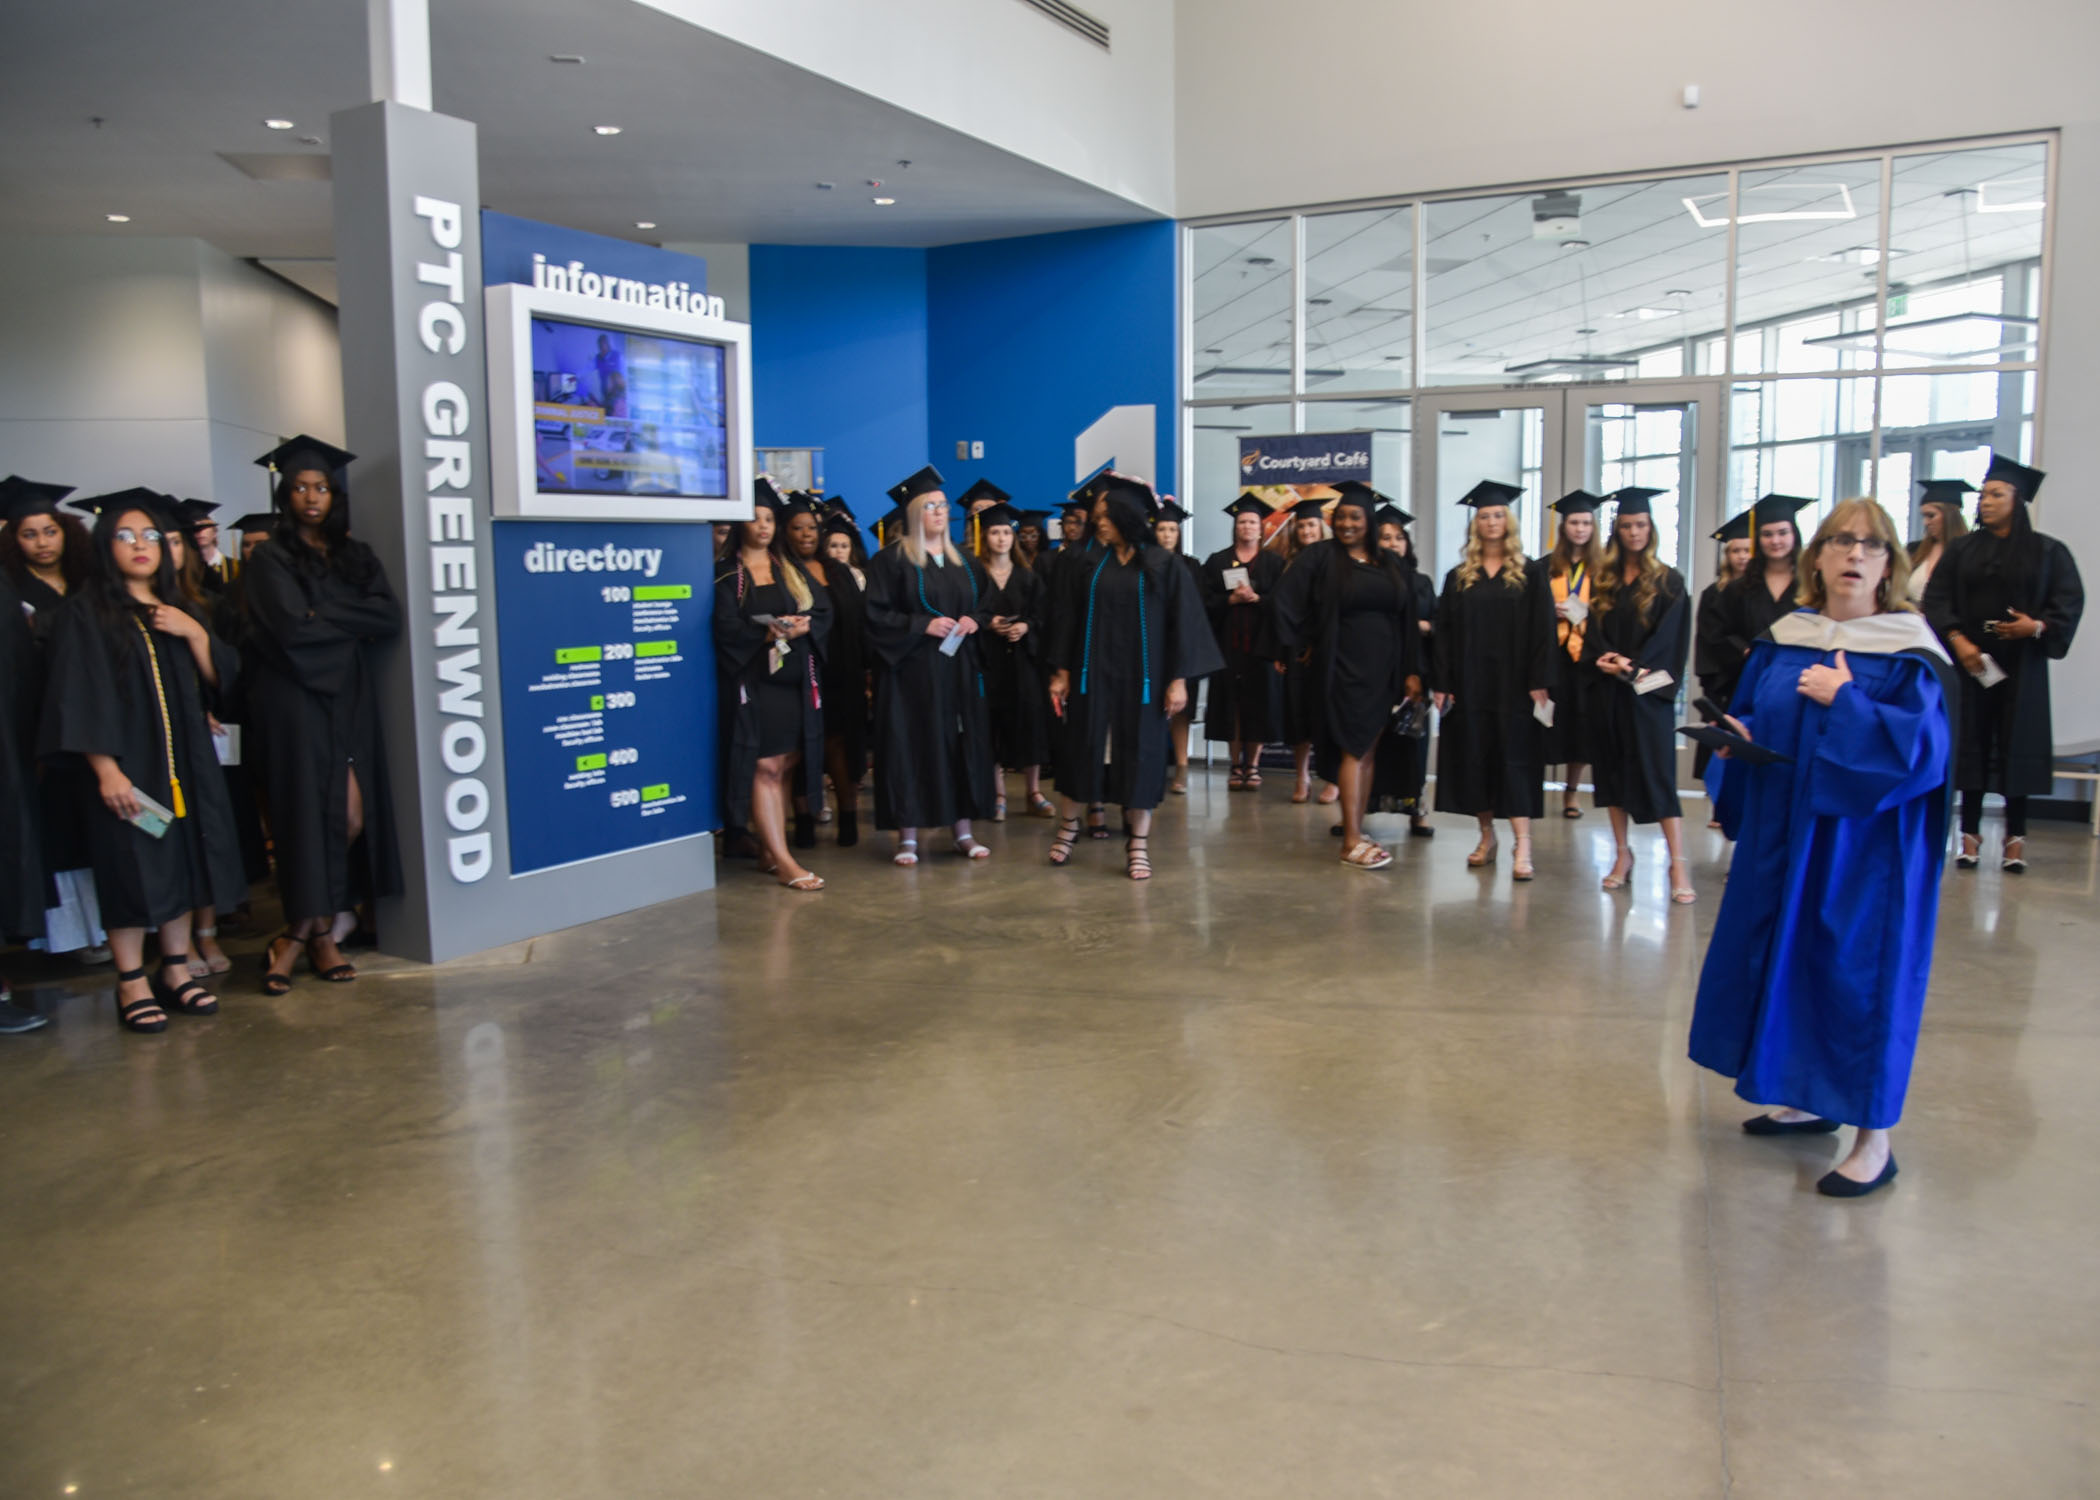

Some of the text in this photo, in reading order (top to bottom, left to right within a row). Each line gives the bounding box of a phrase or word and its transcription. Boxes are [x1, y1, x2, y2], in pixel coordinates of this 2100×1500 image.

[532, 253, 726, 320] information
[1259, 451, 1369, 472] Courtyard Café
[414, 195, 493, 882] PTC GREENWOOD
[524, 541, 663, 578] directory
[601, 586, 632, 602] 100
[603, 643, 635, 660] 200
[606, 691, 636, 709] 300
[609, 747, 639, 766] 400
[610, 788, 640, 808] 500
